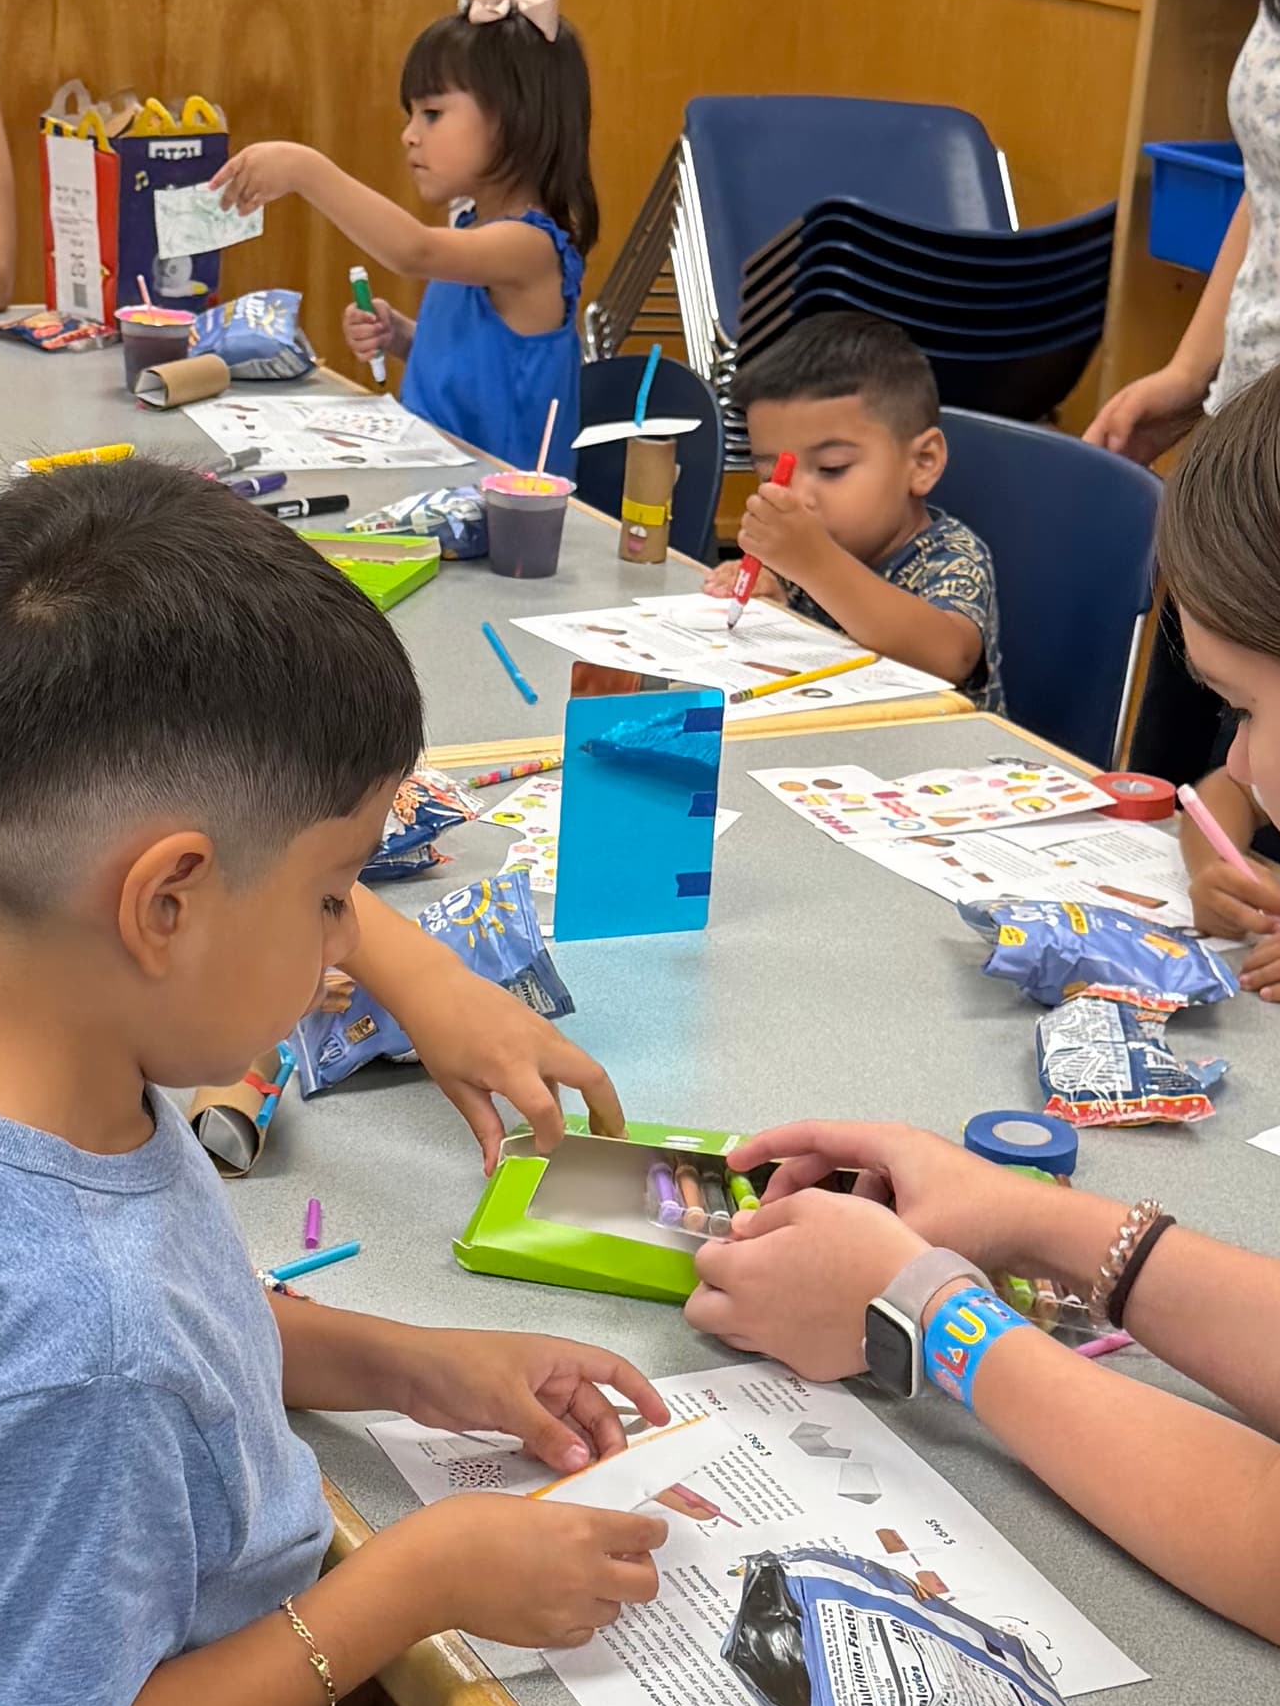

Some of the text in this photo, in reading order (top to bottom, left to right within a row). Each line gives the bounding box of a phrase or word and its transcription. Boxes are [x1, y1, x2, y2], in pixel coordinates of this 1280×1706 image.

[921, 1518, 950, 1537] Step
[844, 1608, 861, 1647] Facts
[890, 1620, 909, 1644] 140
